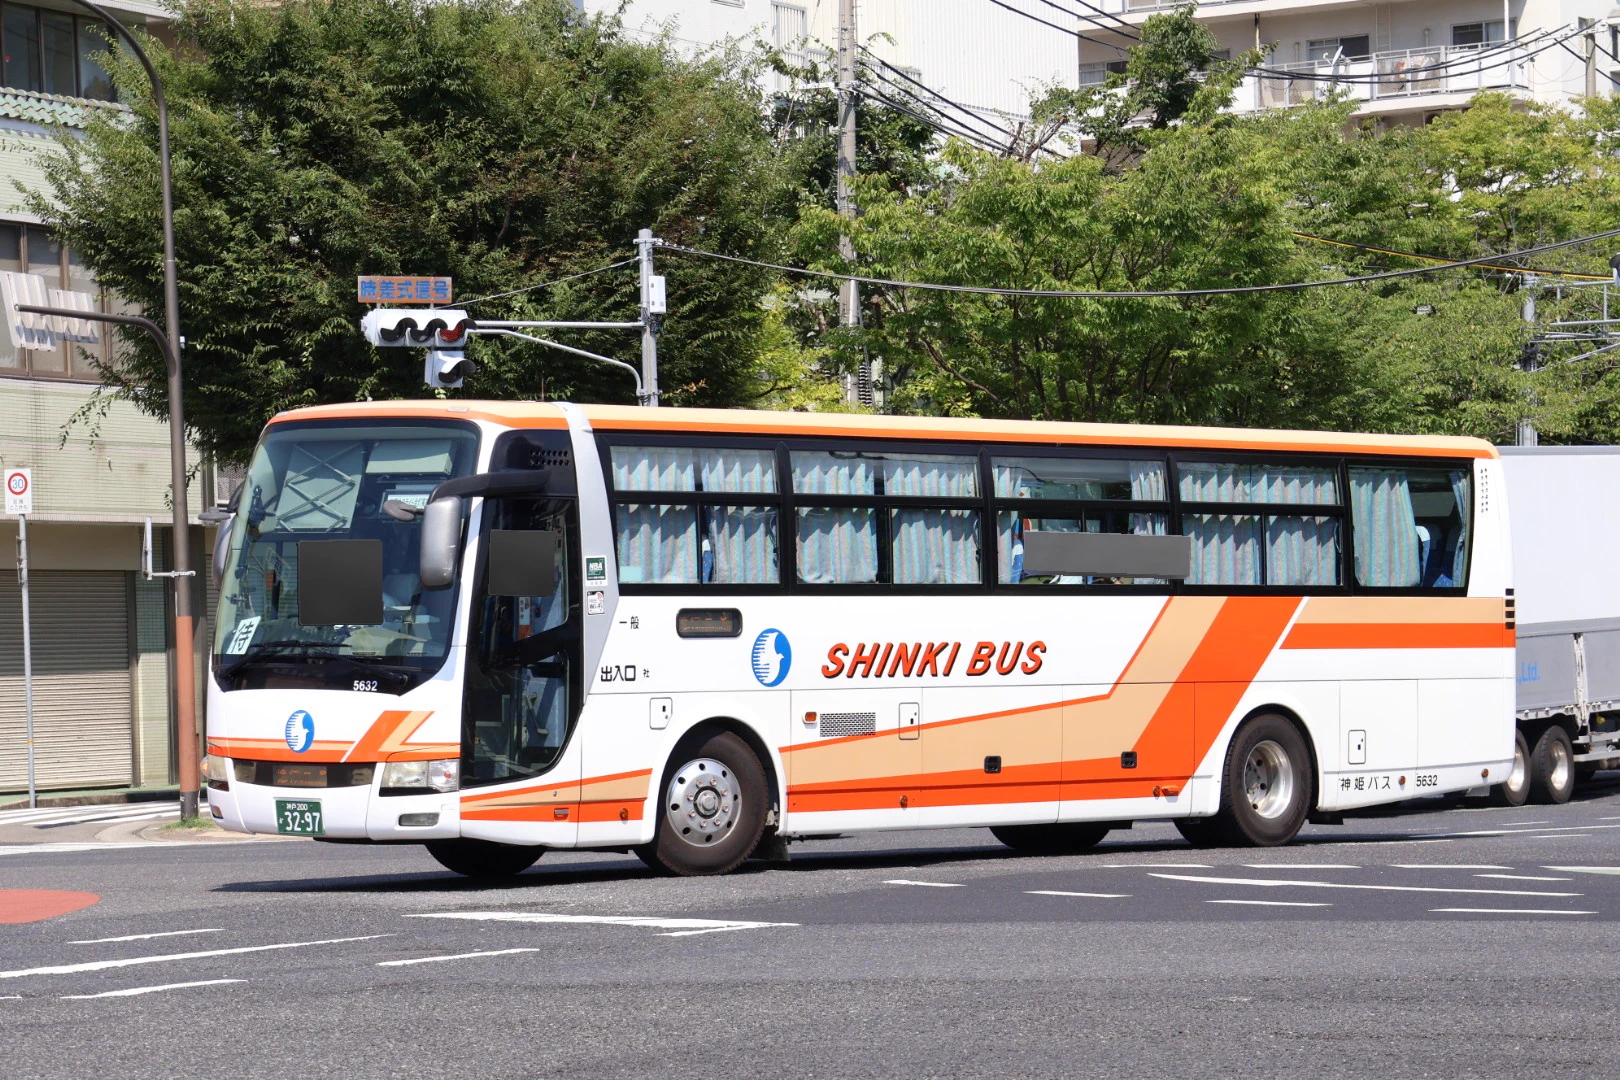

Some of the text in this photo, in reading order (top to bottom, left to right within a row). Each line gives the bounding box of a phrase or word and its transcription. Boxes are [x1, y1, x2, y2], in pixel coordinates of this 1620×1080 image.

[360, 279, 449, 300] 時差式信号
[12, 478, 24, 490] 30
[589, 562, 603, 571] NBA
[619, 615, 639, 630] 一般
[821, 640, 1047, 680] SHINKI BUS
[600, 664, 650, 683] 出入口 社
[353, 680, 378, 692] 5632
[1340, 774, 1438, 792] 神姫バス 5632
[284, 811, 321, 832] 32-97
